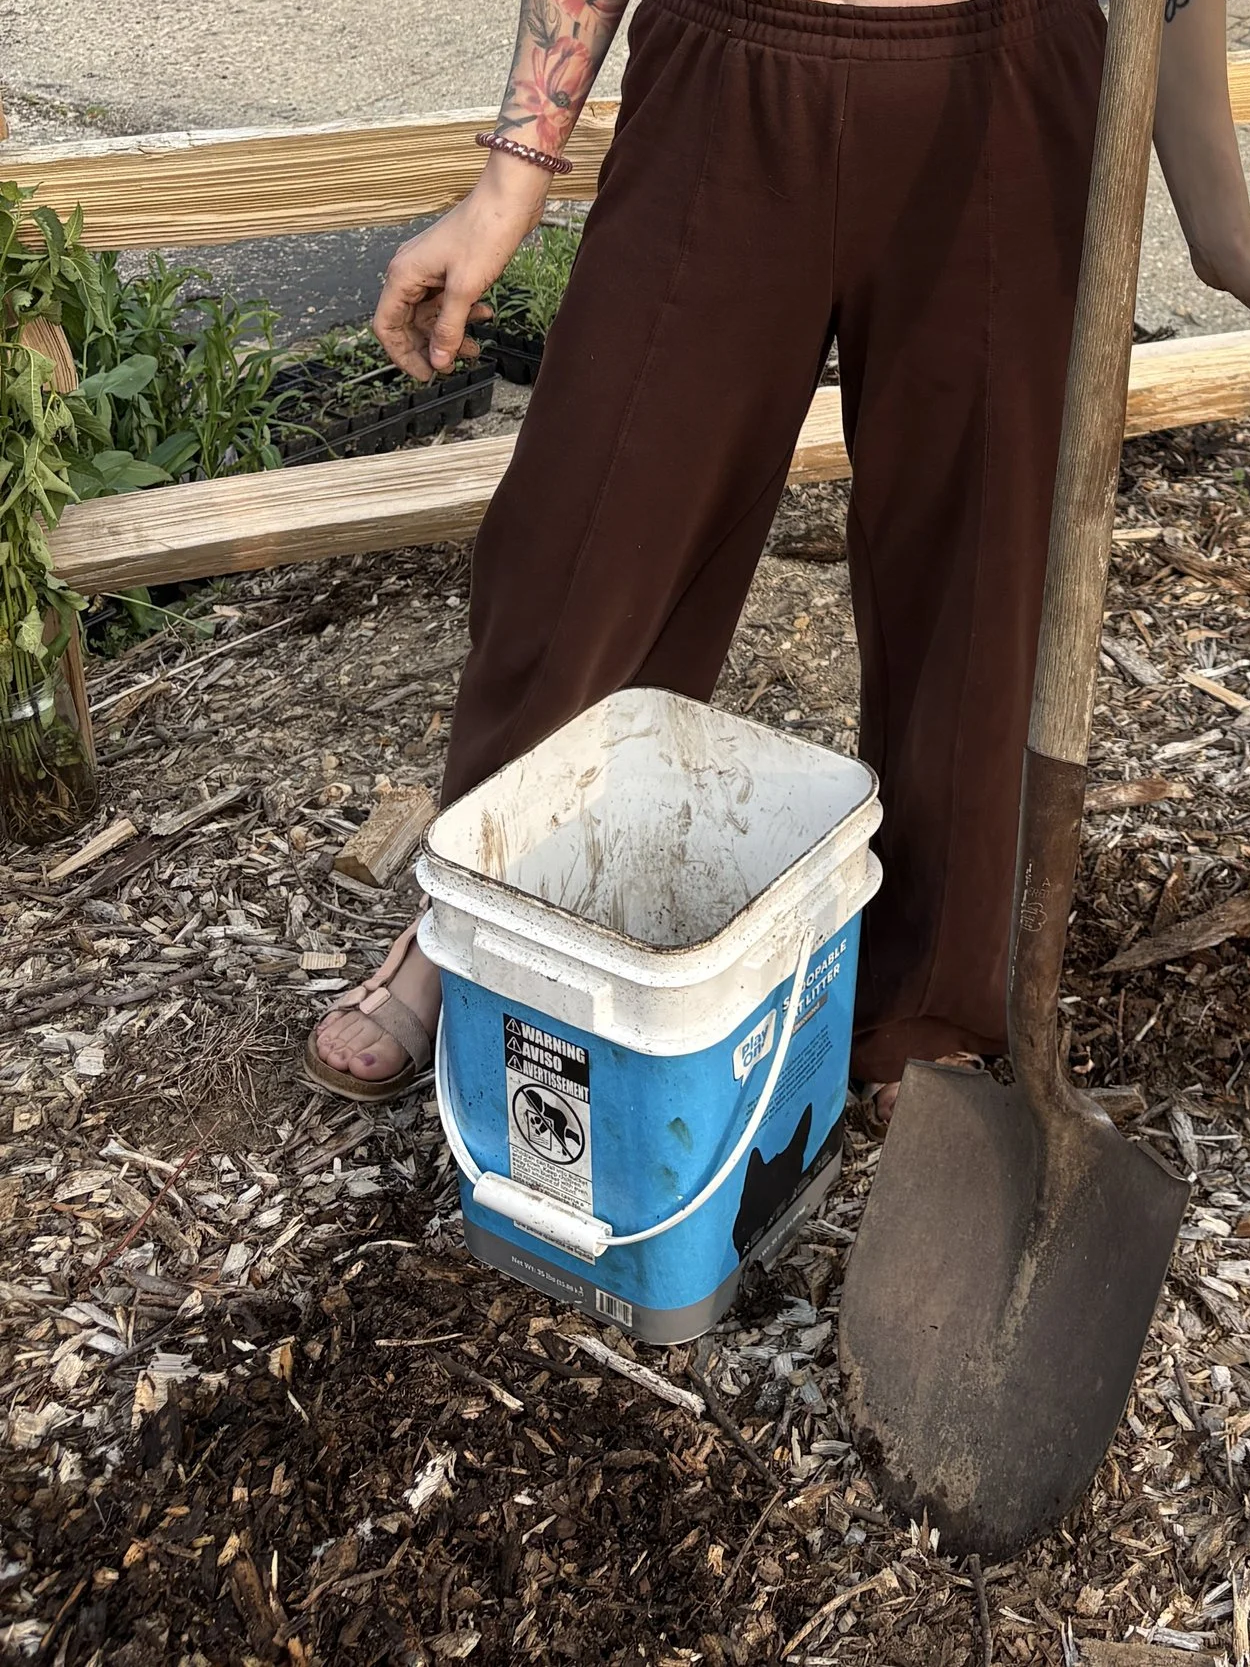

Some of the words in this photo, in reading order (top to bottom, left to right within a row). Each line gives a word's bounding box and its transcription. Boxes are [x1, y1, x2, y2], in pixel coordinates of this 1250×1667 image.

[782, 938, 847, 1012] SOPABLE
[806, 963, 840, 1005] LITTER
[521, 1022, 586, 1064] WARNING
[522, 1041, 563, 1072] AVISO
[742, 1024, 769, 1059] Play
[522, 1059, 589, 1102] AVERTISSEMENT
[512, 1255, 523, 1267] Net
[537, 1268, 545, 1278] 35
